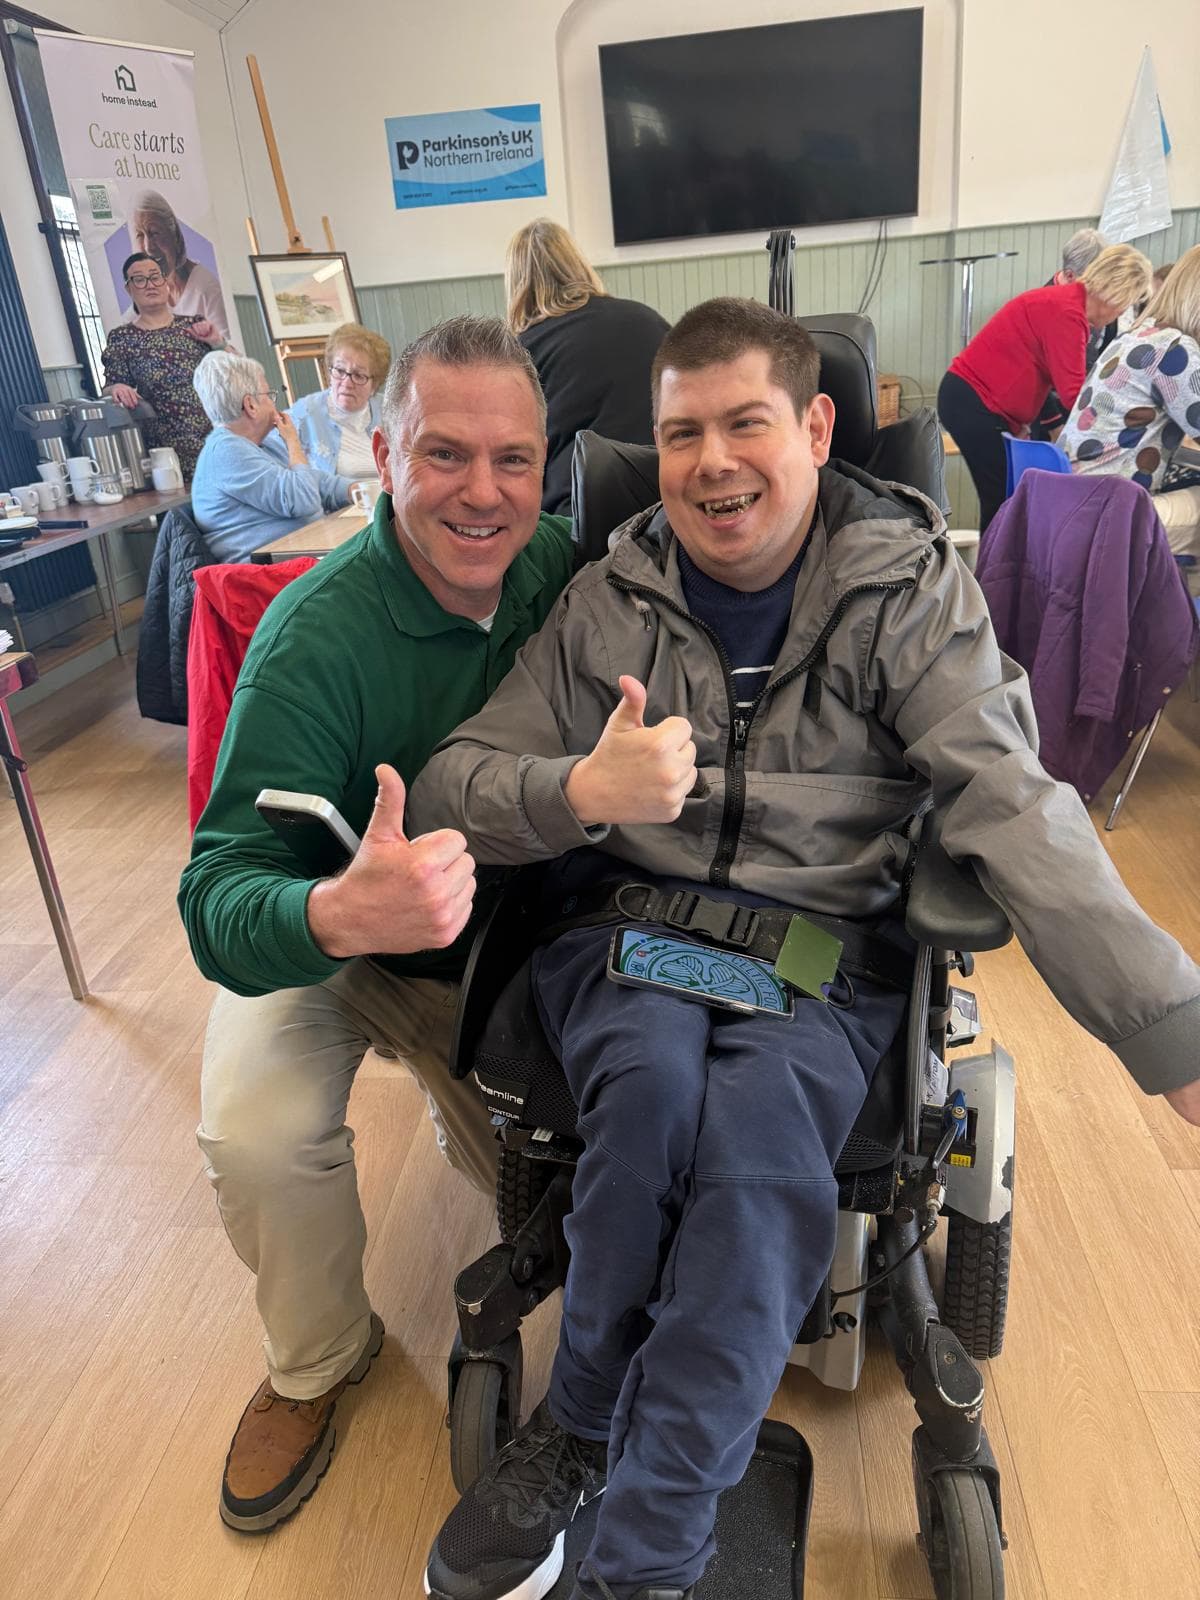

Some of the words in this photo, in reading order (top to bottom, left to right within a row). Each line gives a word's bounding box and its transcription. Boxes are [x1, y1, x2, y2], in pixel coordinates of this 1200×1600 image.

[101, 92, 126, 105] home
[126, 96, 157, 108] instead
[89, 122, 130, 150] Care
[133, 130, 185, 154] starts
[422, 131, 509, 153] Parkinson's
[512, 129, 534, 144] UK
[114, 157, 132, 177] at
[132, 154, 181, 180] home
[423, 151, 483, 168] Northern
[485, 145, 534, 162] Ireland
[487, 1105, 520, 1121] CONTOUR
